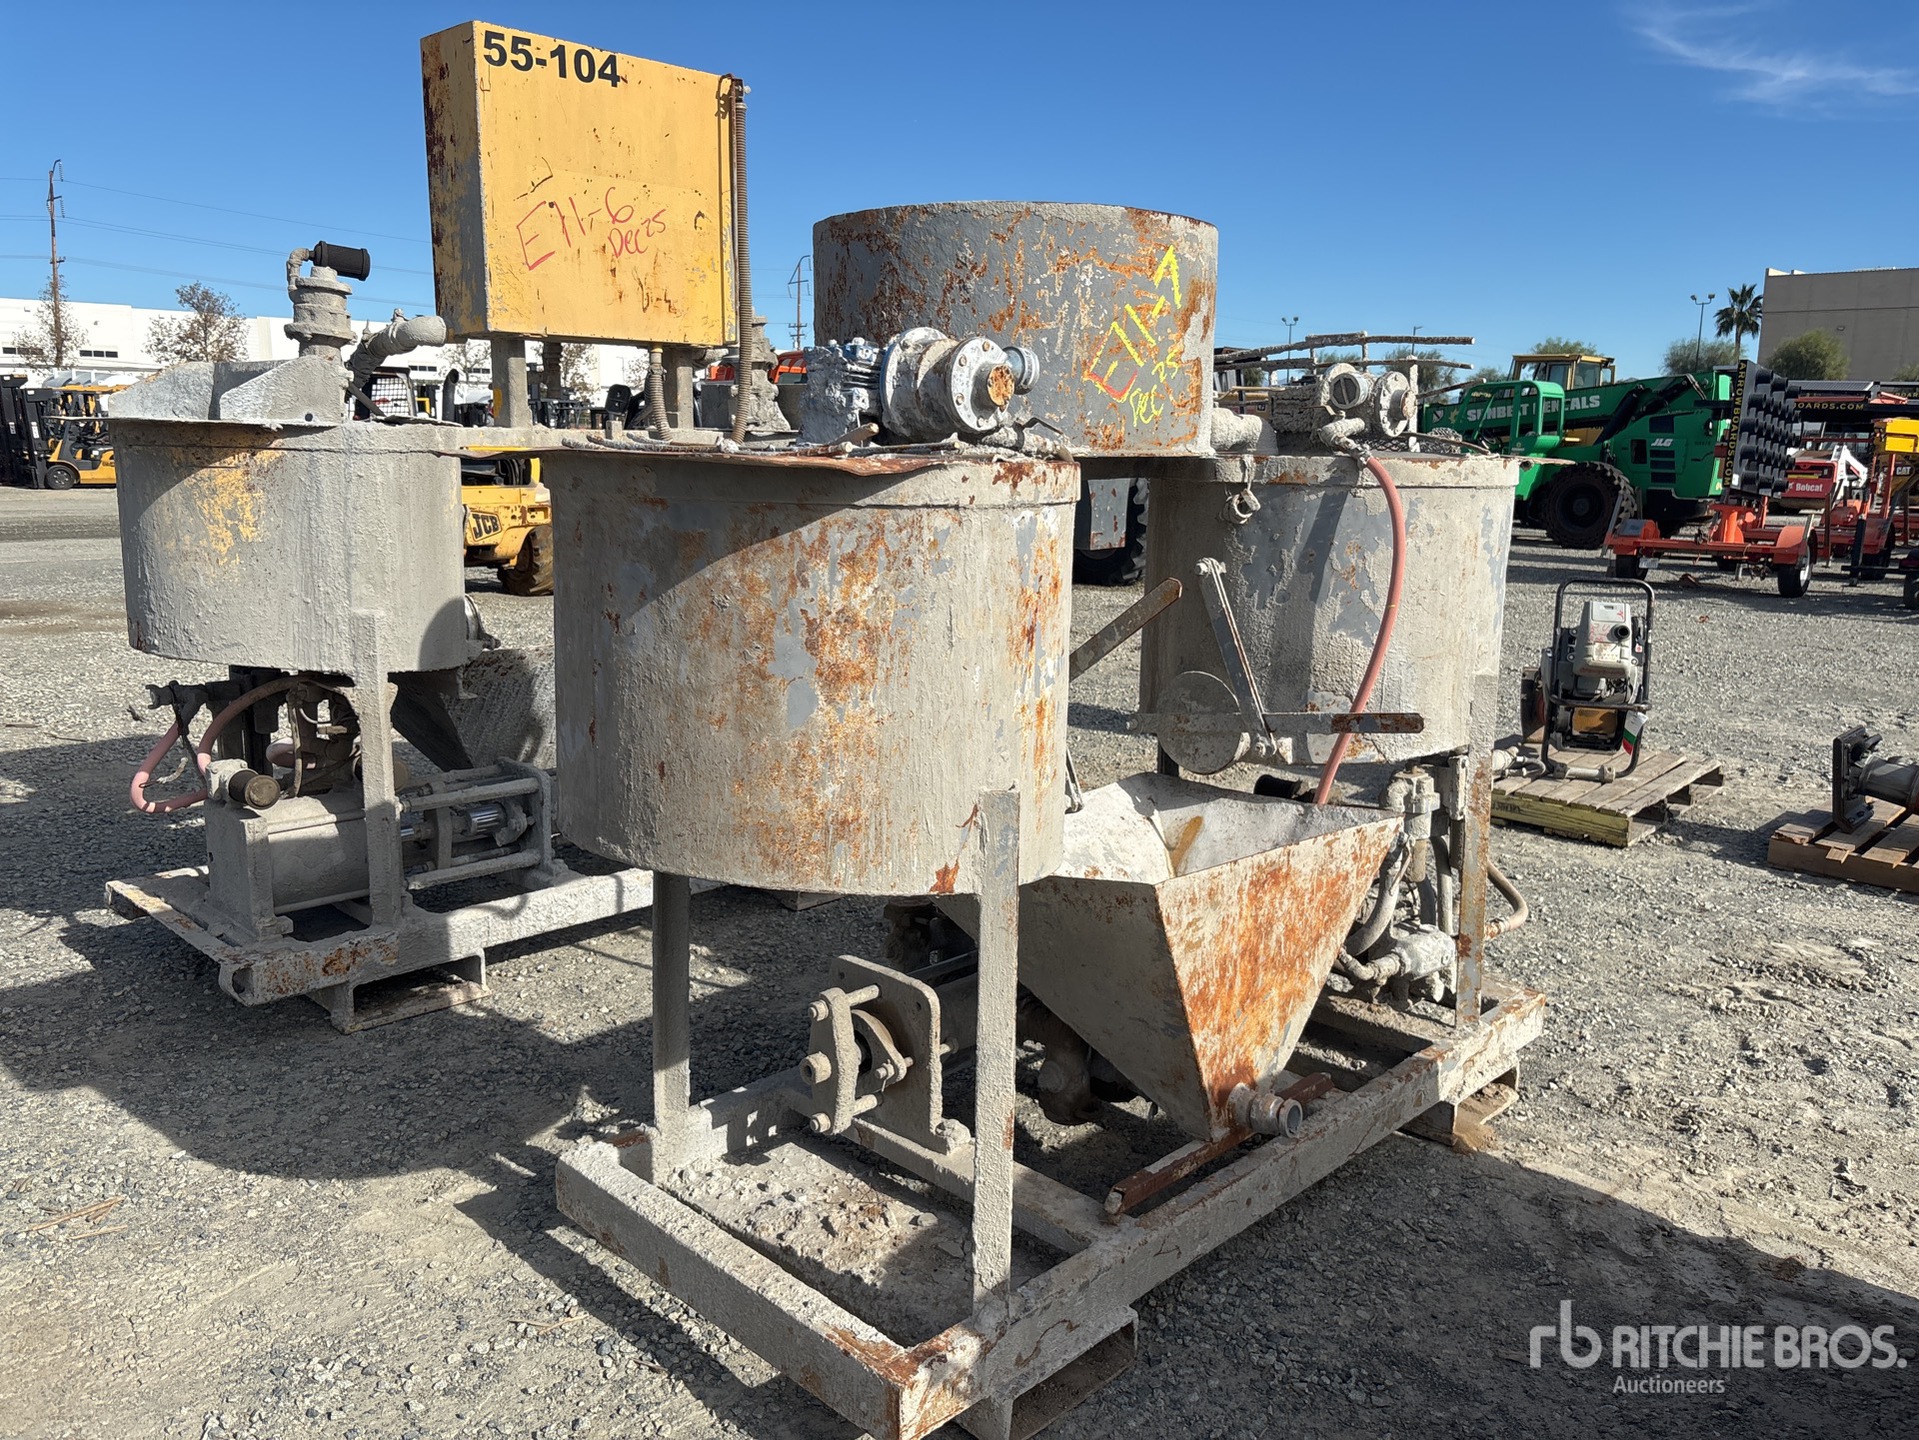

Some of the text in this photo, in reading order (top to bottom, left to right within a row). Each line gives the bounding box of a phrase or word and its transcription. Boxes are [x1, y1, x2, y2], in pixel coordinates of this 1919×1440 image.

[483, 30, 621, 88] 55-104
[1466, 395, 1601, 422] SUNBET ENALS
[1723, 361, 1748, 487] ARROWBOARDS.COM
[1651, 438, 1674, 447] JLG
[1896, 466, 1911, 476] CAT
[1795, 482, 1823, 492] Bobcat
[472, 513, 499, 540] JCB
